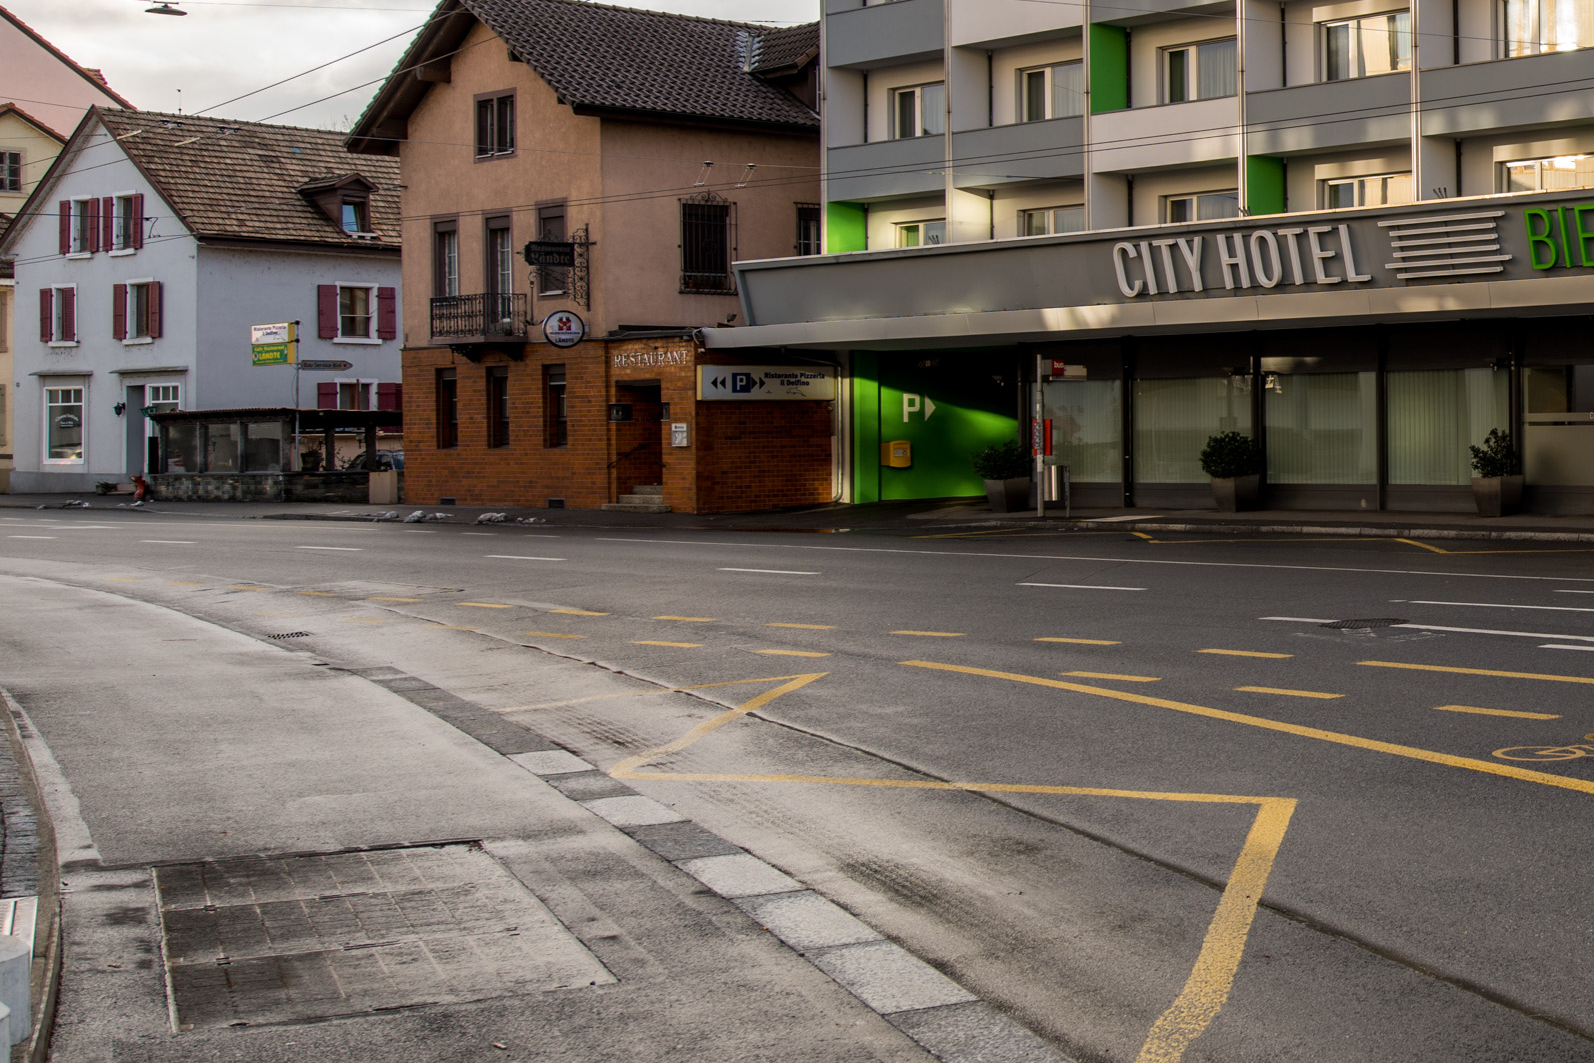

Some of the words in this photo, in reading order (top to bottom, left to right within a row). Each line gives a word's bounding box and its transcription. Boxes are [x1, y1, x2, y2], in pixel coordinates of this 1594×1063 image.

[1112, 236, 1203, 298] CITY
[1216, 224, 1373, 289] HOTEL
[614, 350, 688, 367] RESTAURANT
[1053, 360, 1065, 368] bus
[736, 374, 747, 391] P
[764, 371, 798, 379] Ristorante
[800, 371, 825, 379] Pizzeria
[902, 393, 920, 422] P
